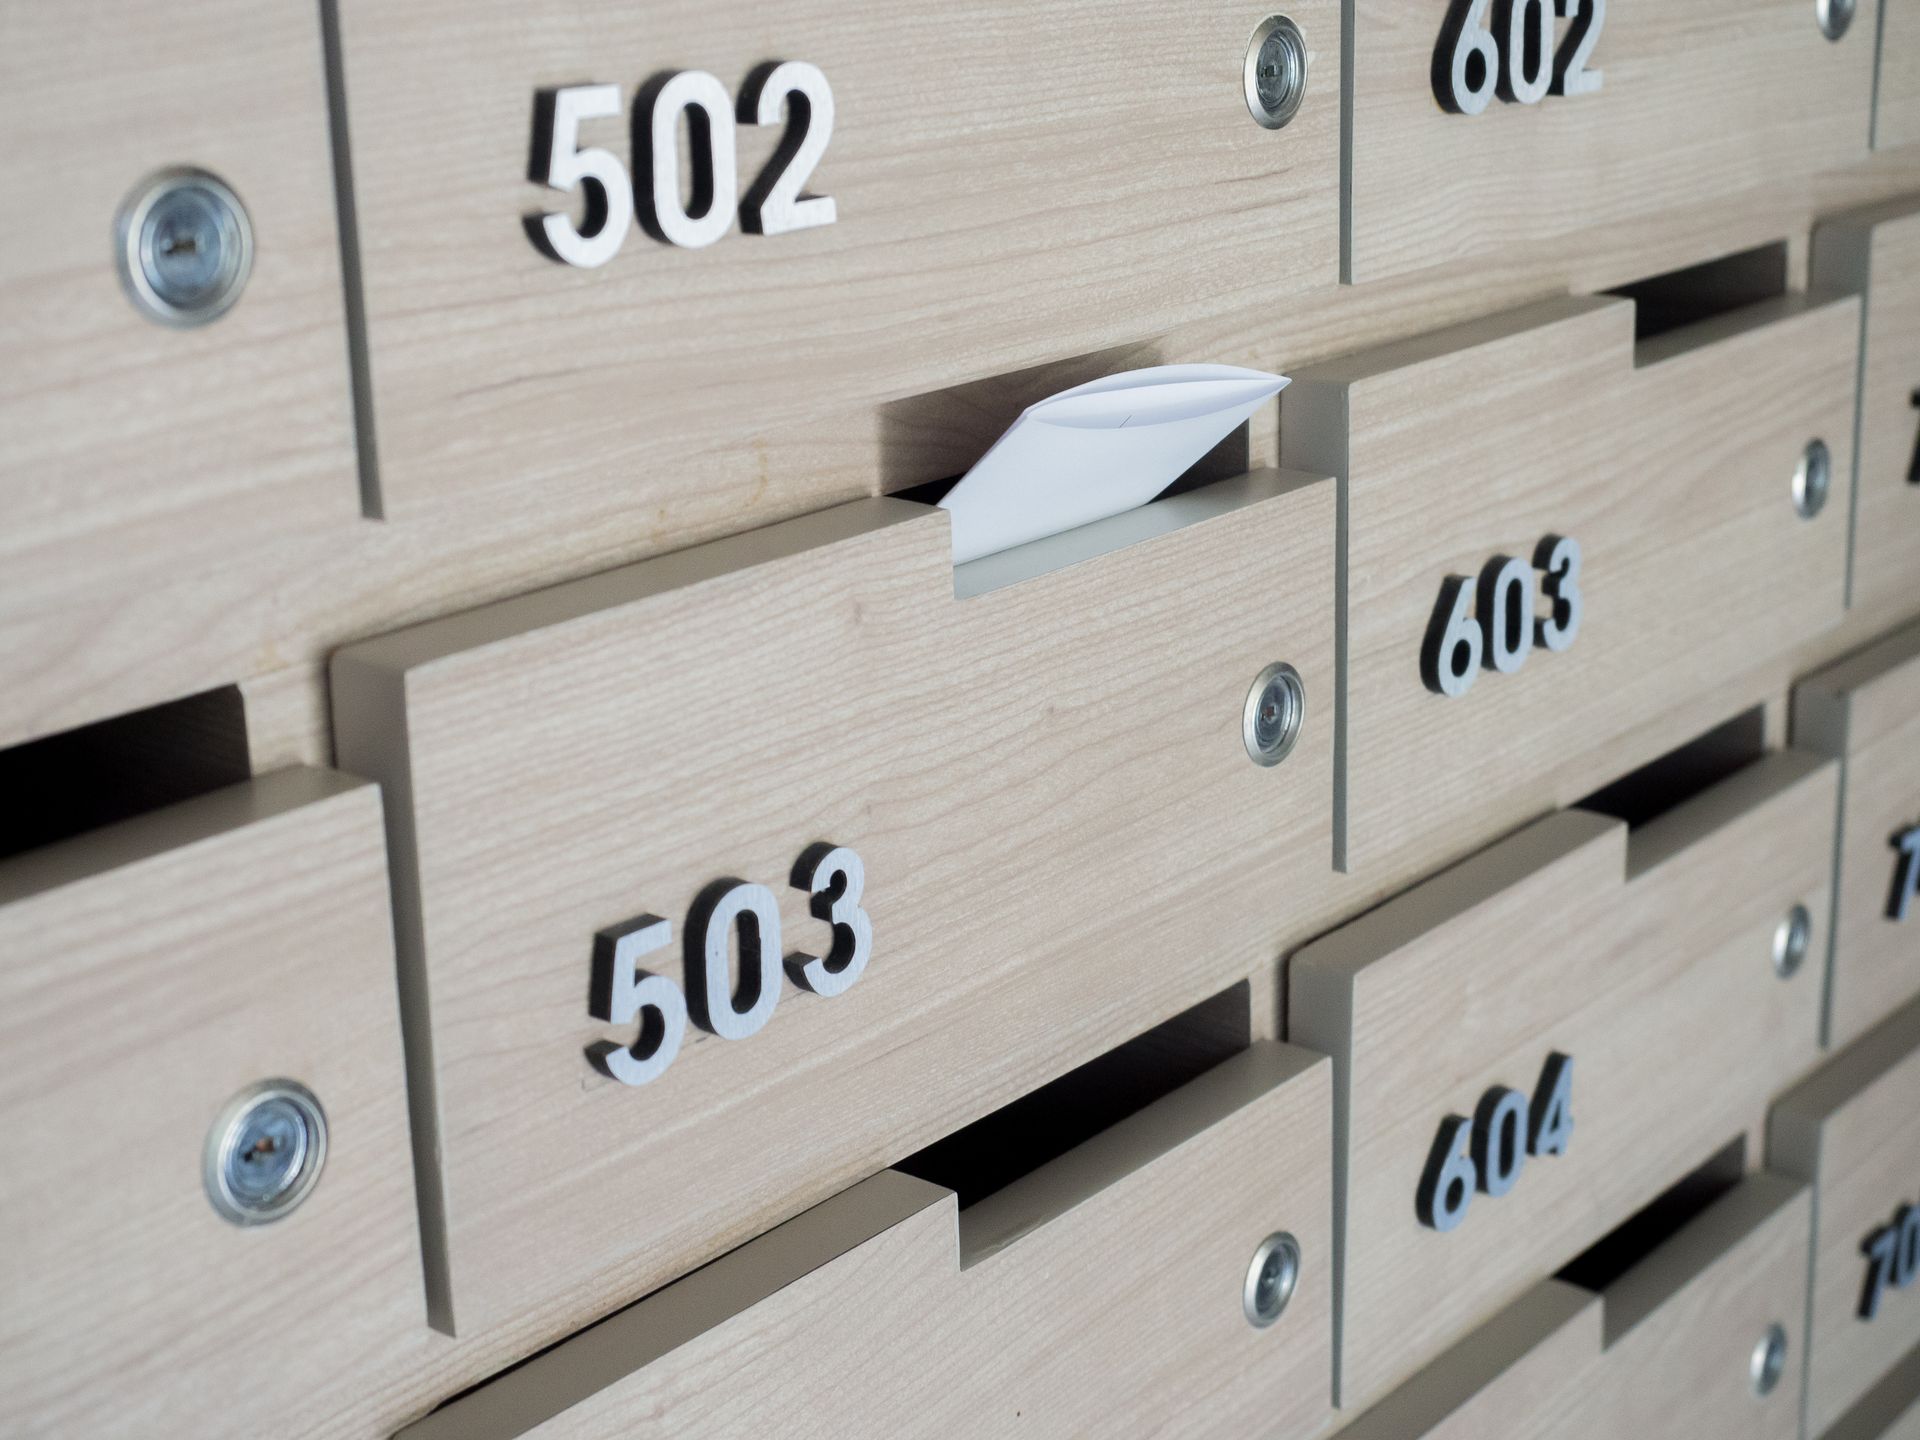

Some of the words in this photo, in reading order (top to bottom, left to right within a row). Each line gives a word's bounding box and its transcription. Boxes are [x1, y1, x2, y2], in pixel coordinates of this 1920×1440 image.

[1431, 0, 1606, 115] 602
[523, 59, 837, 268] 502
[1420, 533, 1584, 697] 603
[584, 842, 872, 1086] 503
[1415, 1051, 1574, 1232] 604
